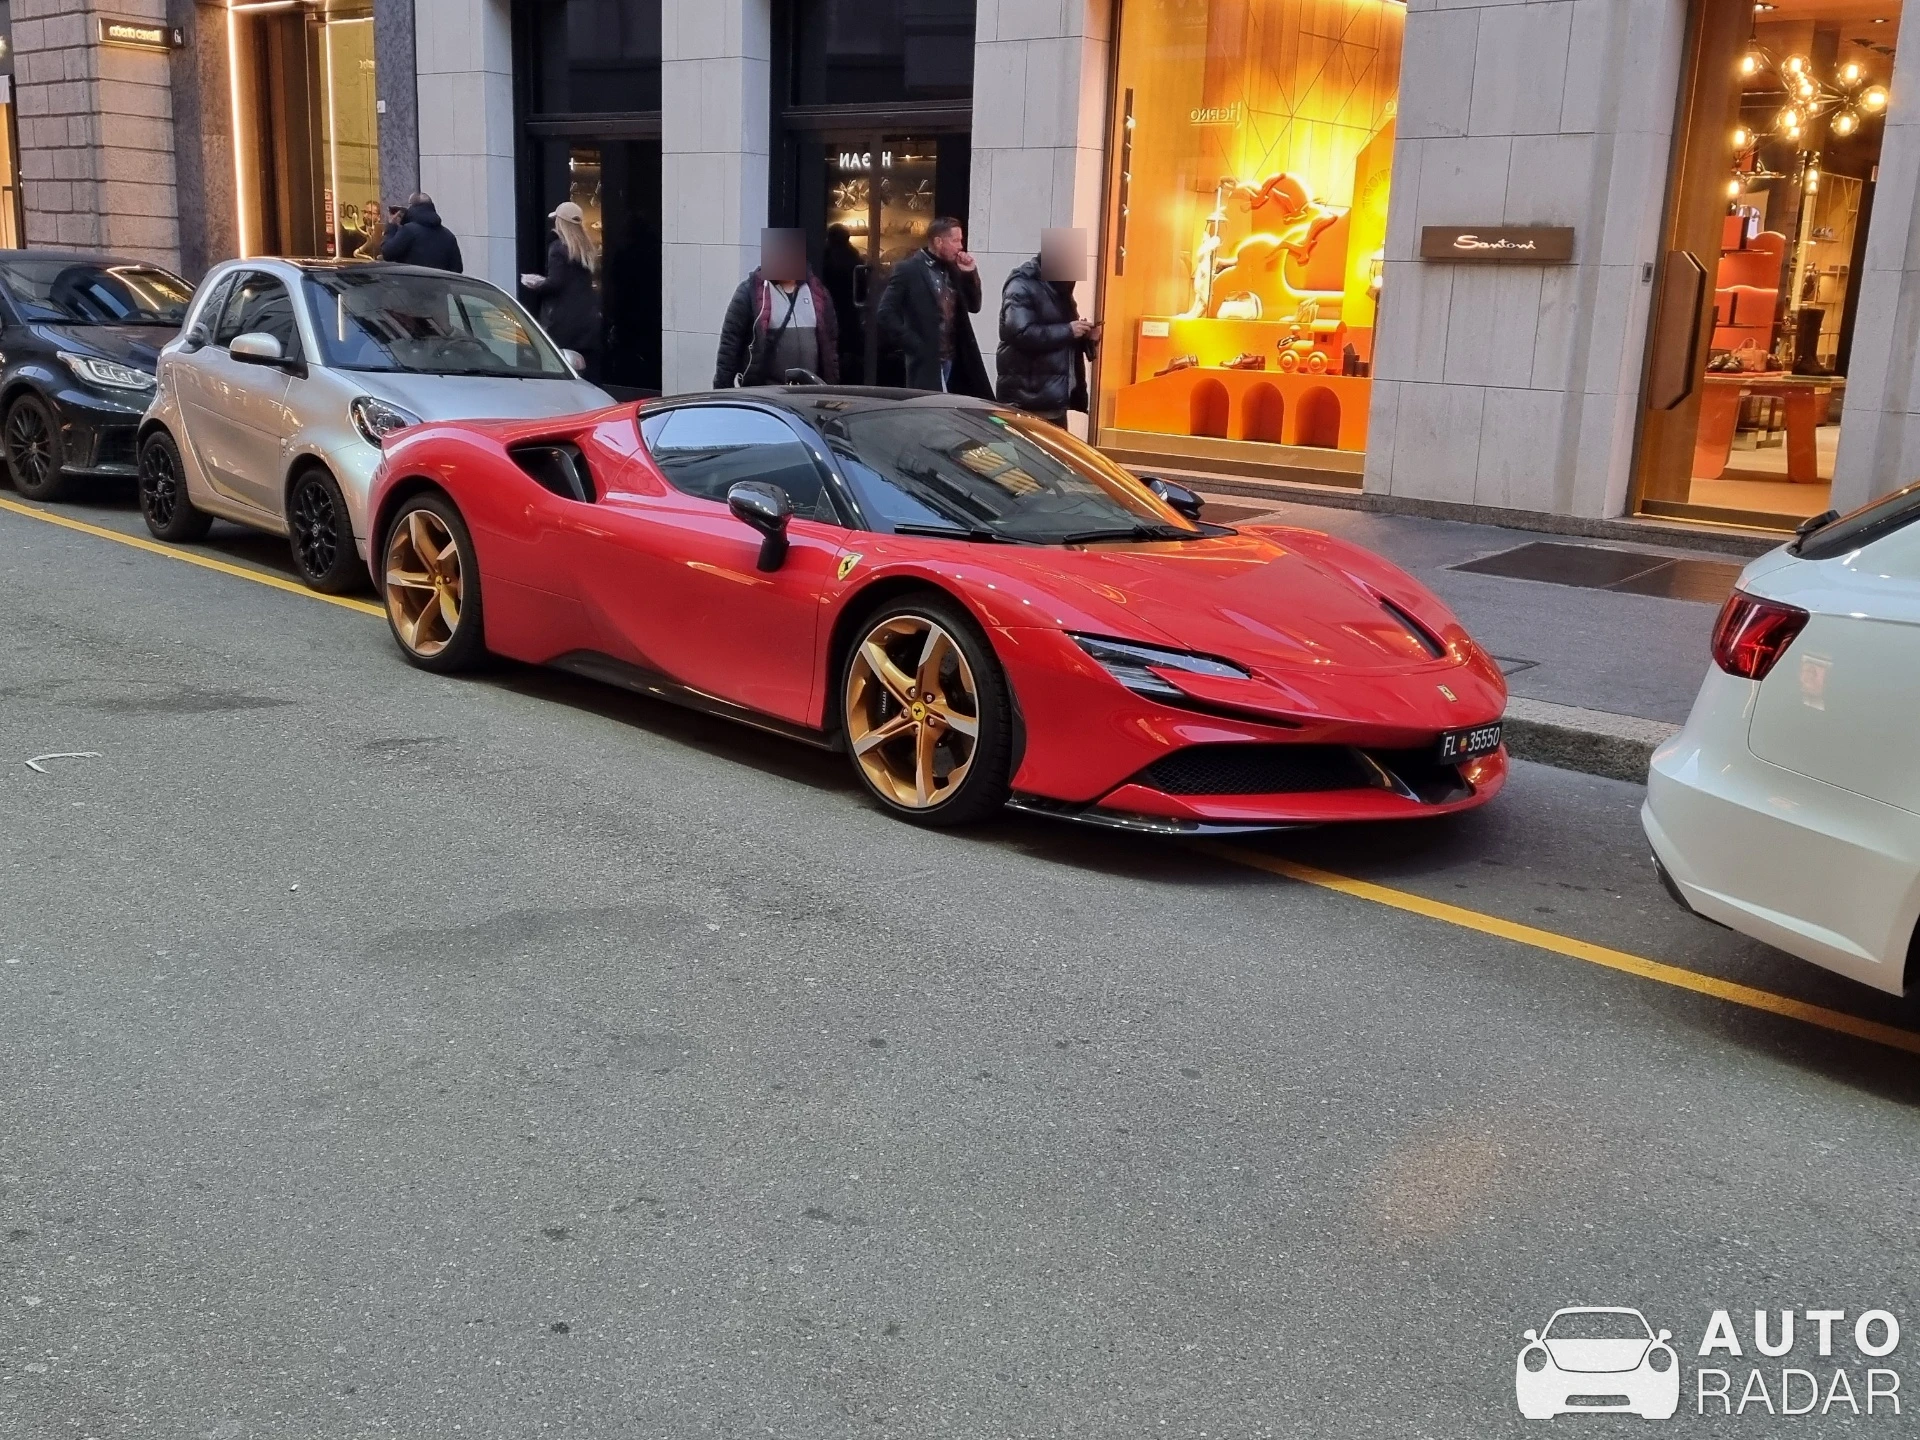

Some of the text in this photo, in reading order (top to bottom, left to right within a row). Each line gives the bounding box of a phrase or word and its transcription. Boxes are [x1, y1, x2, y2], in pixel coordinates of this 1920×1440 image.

[1453, 235, 1536, 250] Santoni
[1443, 727, 1501, 757] FL 35550
